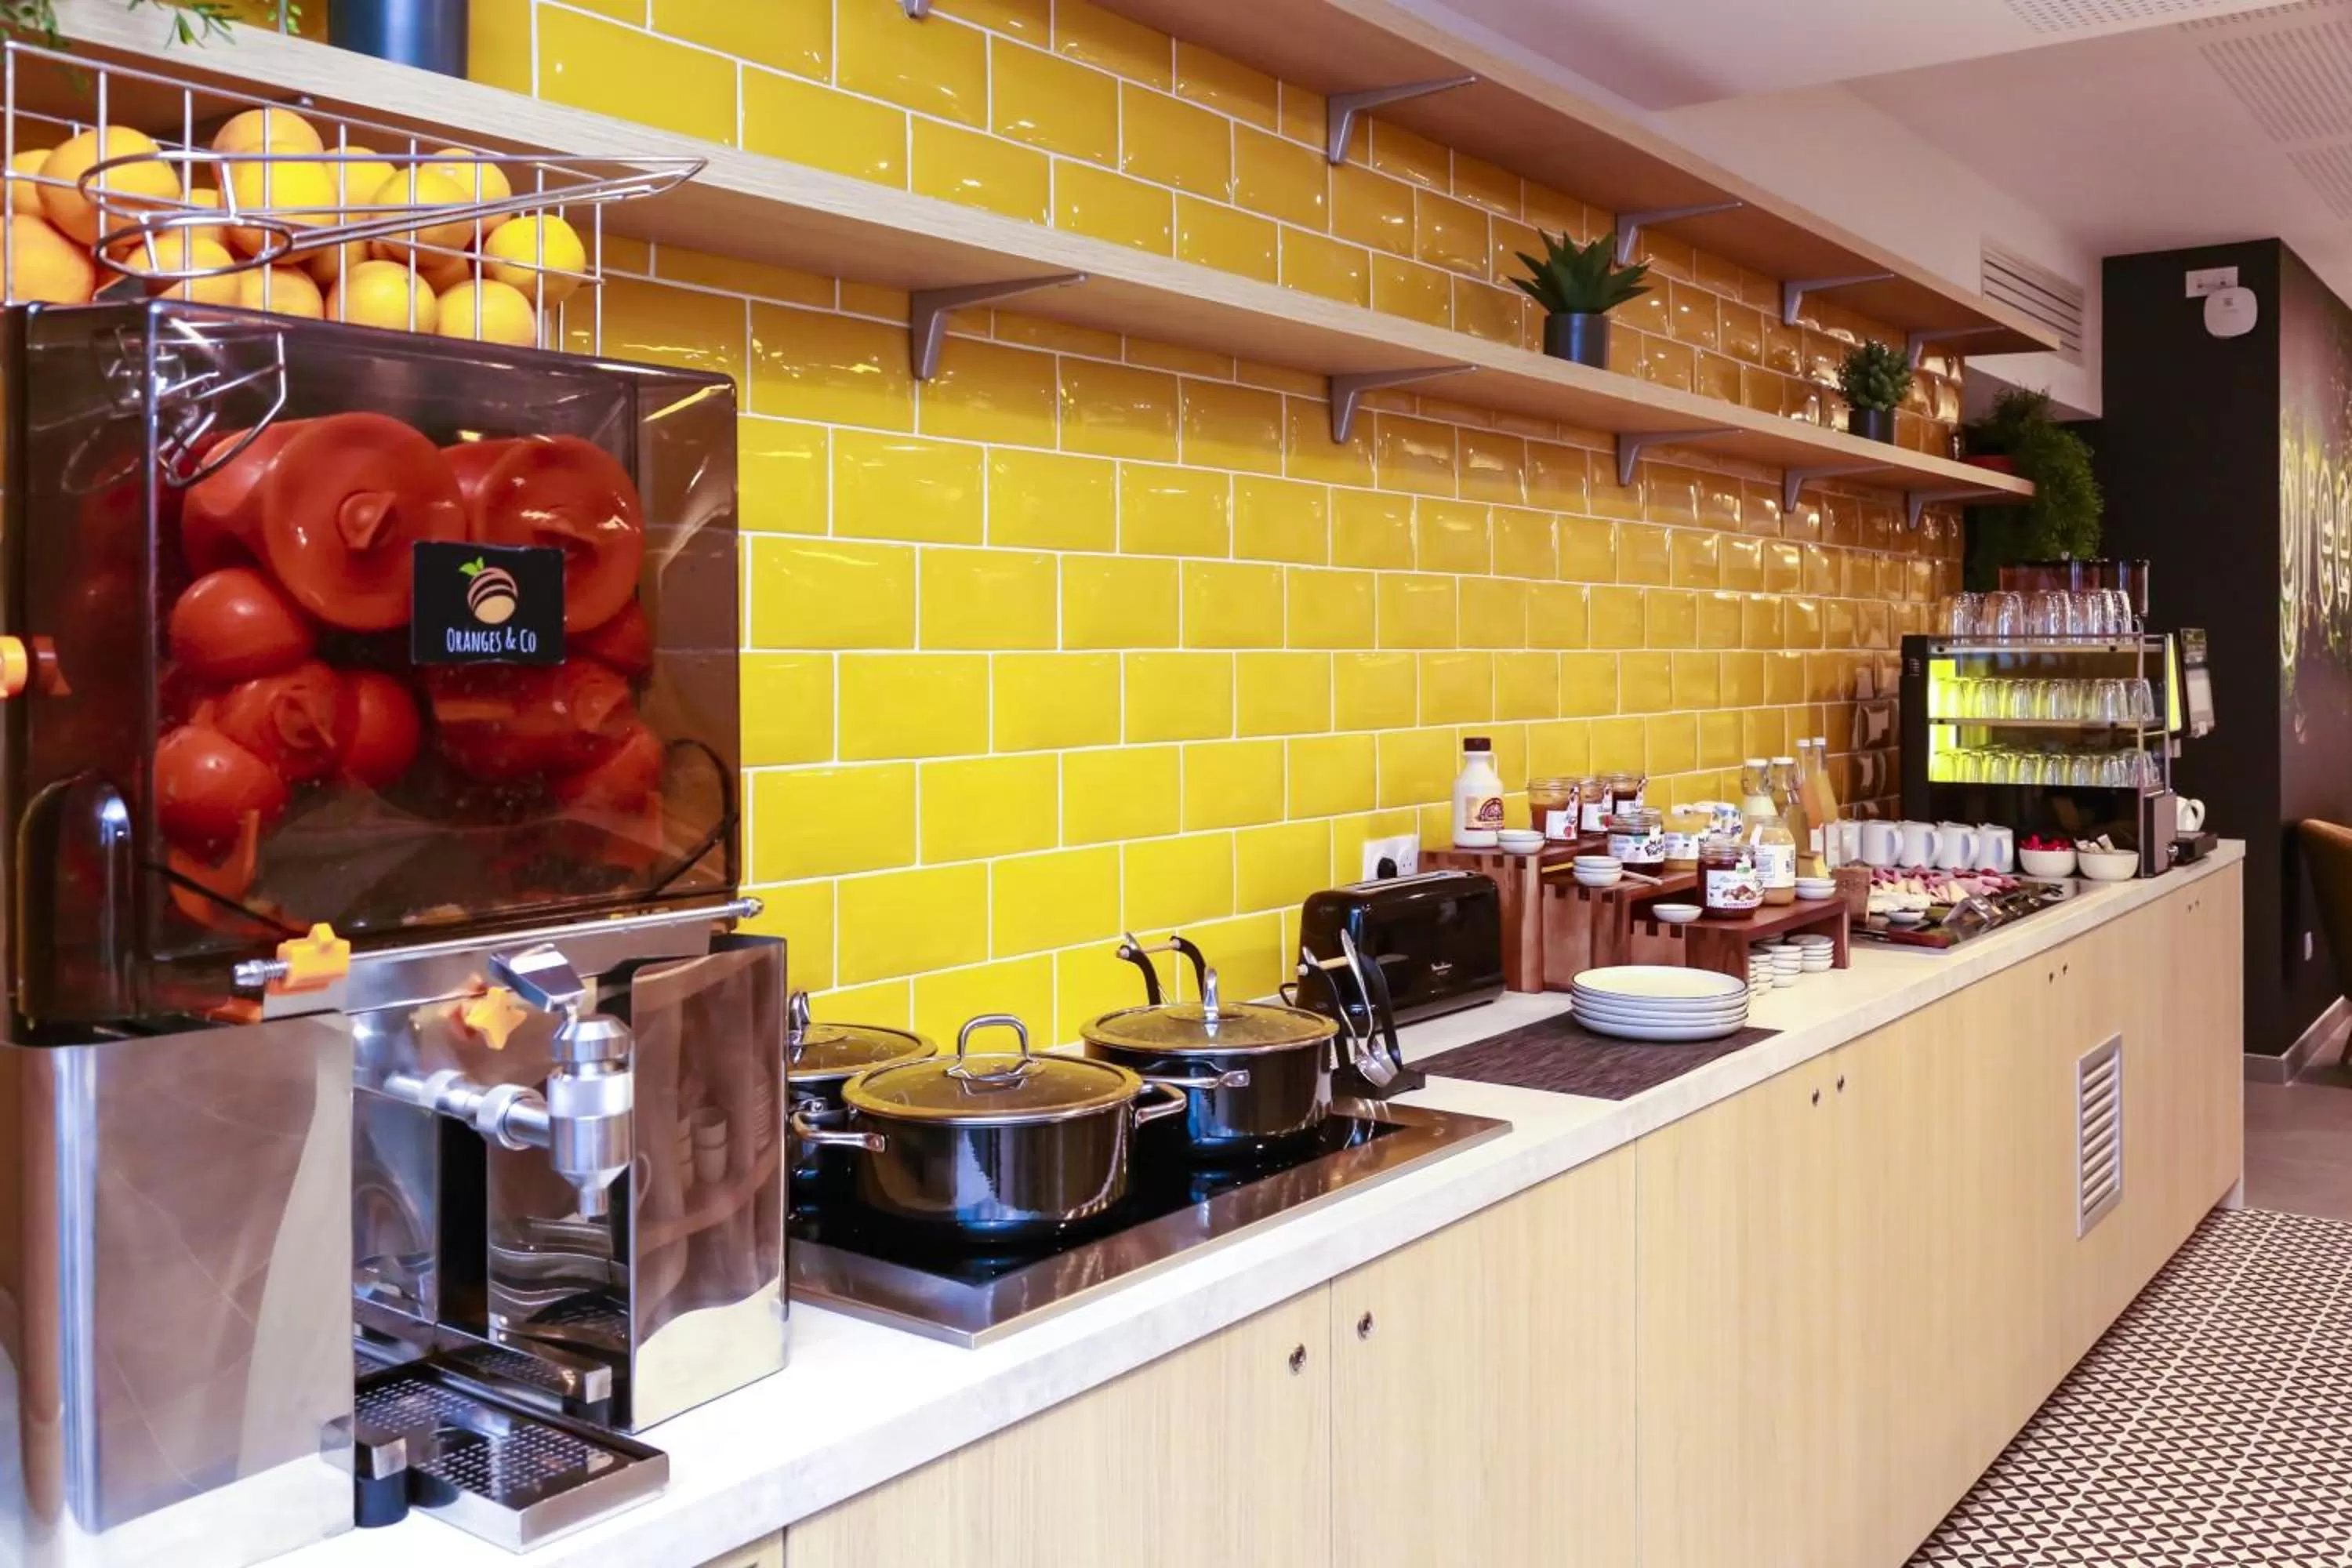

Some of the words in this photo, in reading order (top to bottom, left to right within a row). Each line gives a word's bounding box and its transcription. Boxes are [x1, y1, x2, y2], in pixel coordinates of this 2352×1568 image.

[446, 627, 502, 653] ORANGES
[505, 626, 517, 651] &
[520, 628, 537, 653] CO
